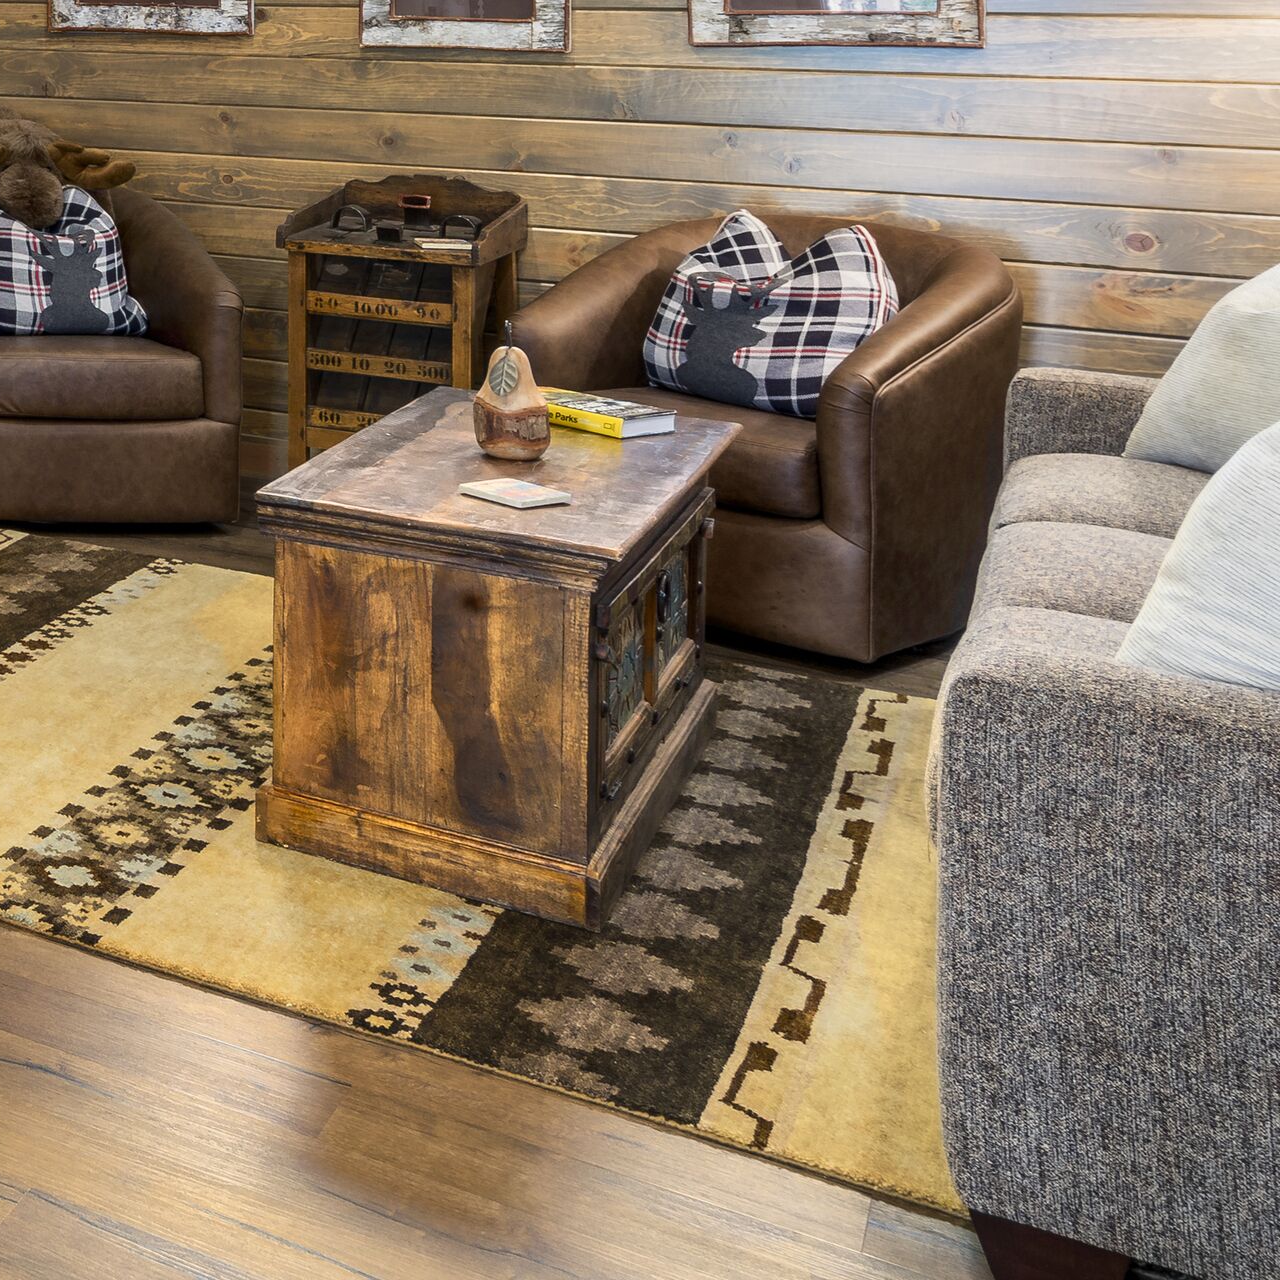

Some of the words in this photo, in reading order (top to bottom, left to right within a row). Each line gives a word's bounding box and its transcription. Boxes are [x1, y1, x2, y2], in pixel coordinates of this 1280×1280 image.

[351, 356, 371, 371] 10
[383, 360, 407, 376] 20
[318, 409, 341, 425] 60
[555, 410, 579, 424] Parks
